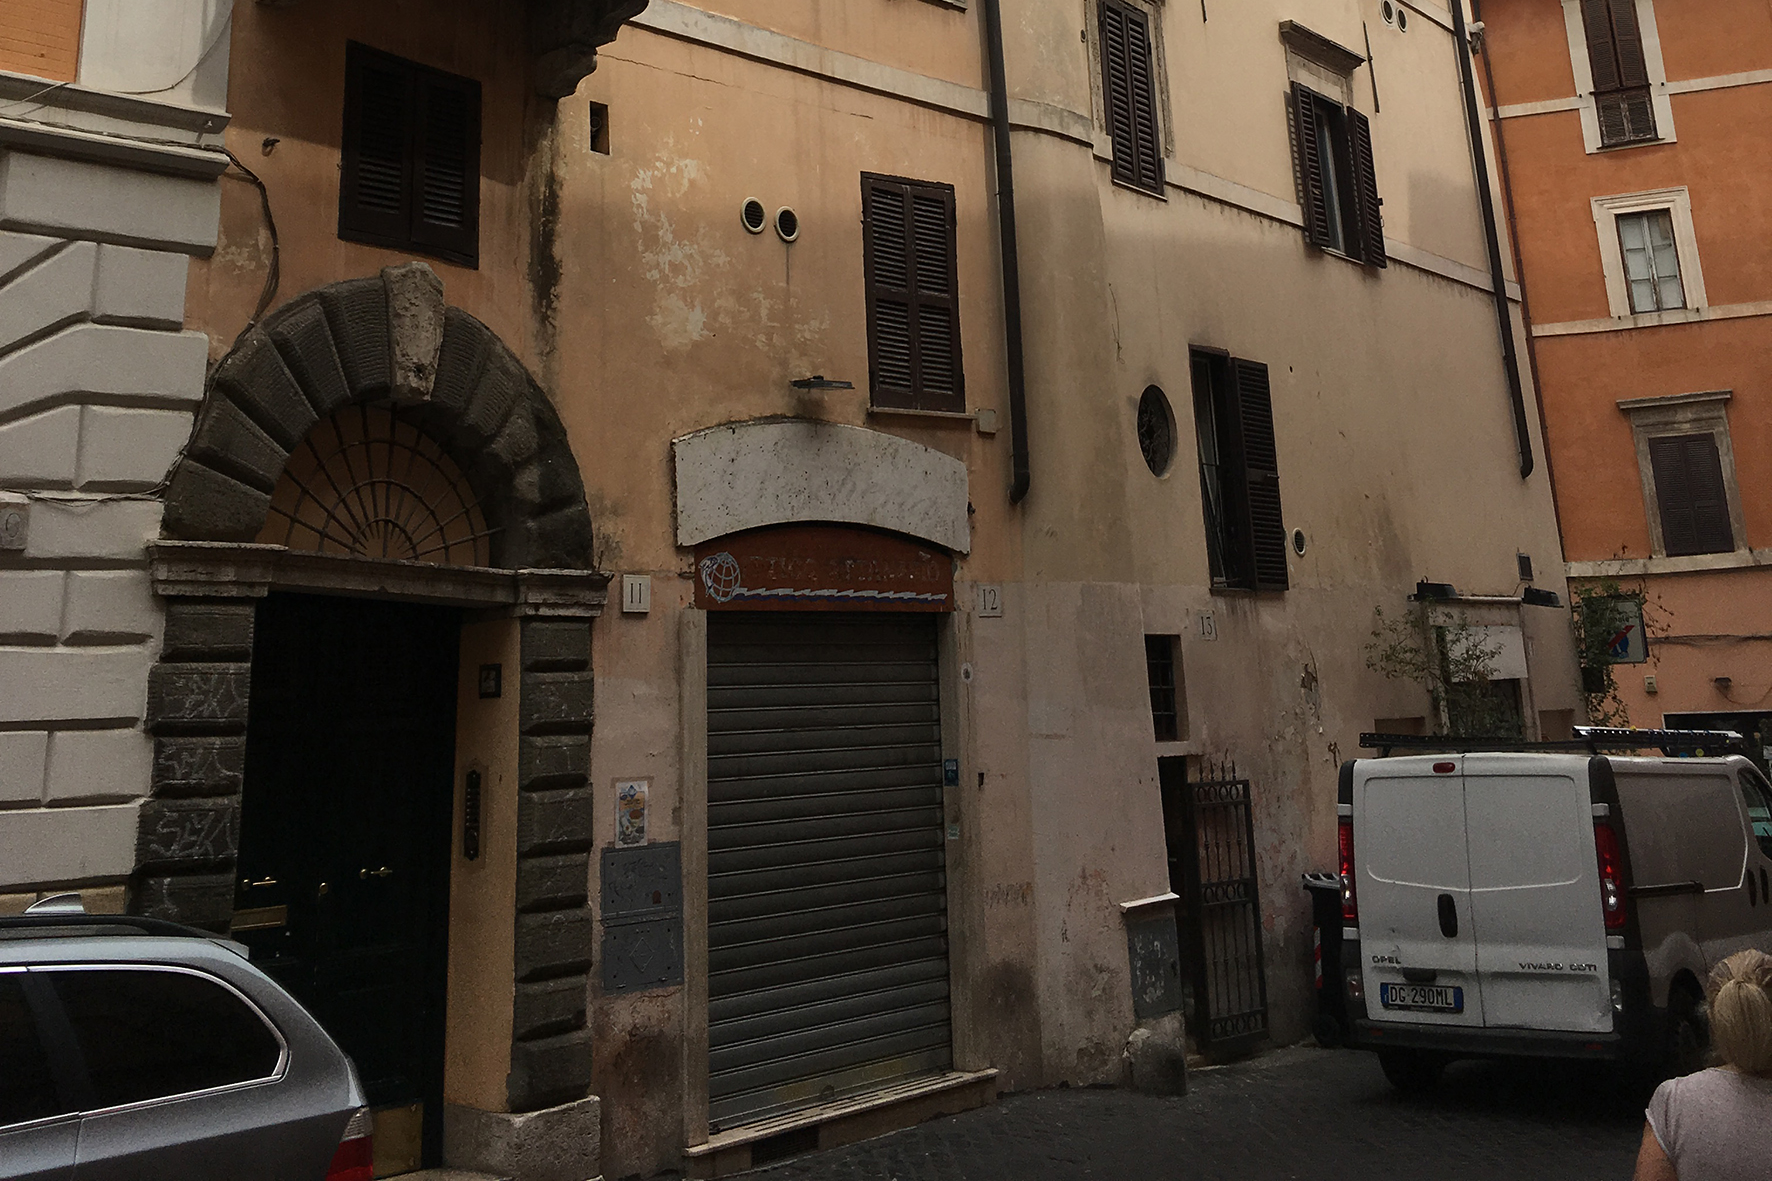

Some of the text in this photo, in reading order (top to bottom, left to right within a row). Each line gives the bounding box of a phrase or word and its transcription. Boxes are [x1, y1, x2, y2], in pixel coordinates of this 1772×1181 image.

[630, 582, 642, 604] 11
[982, 588, 998, 610] 12
[1200, 616, 1213, 636] 13
[1371, 955, 1401, 965] OPEL
[1518, 962, 1597, 972] VIVARO CDTI
